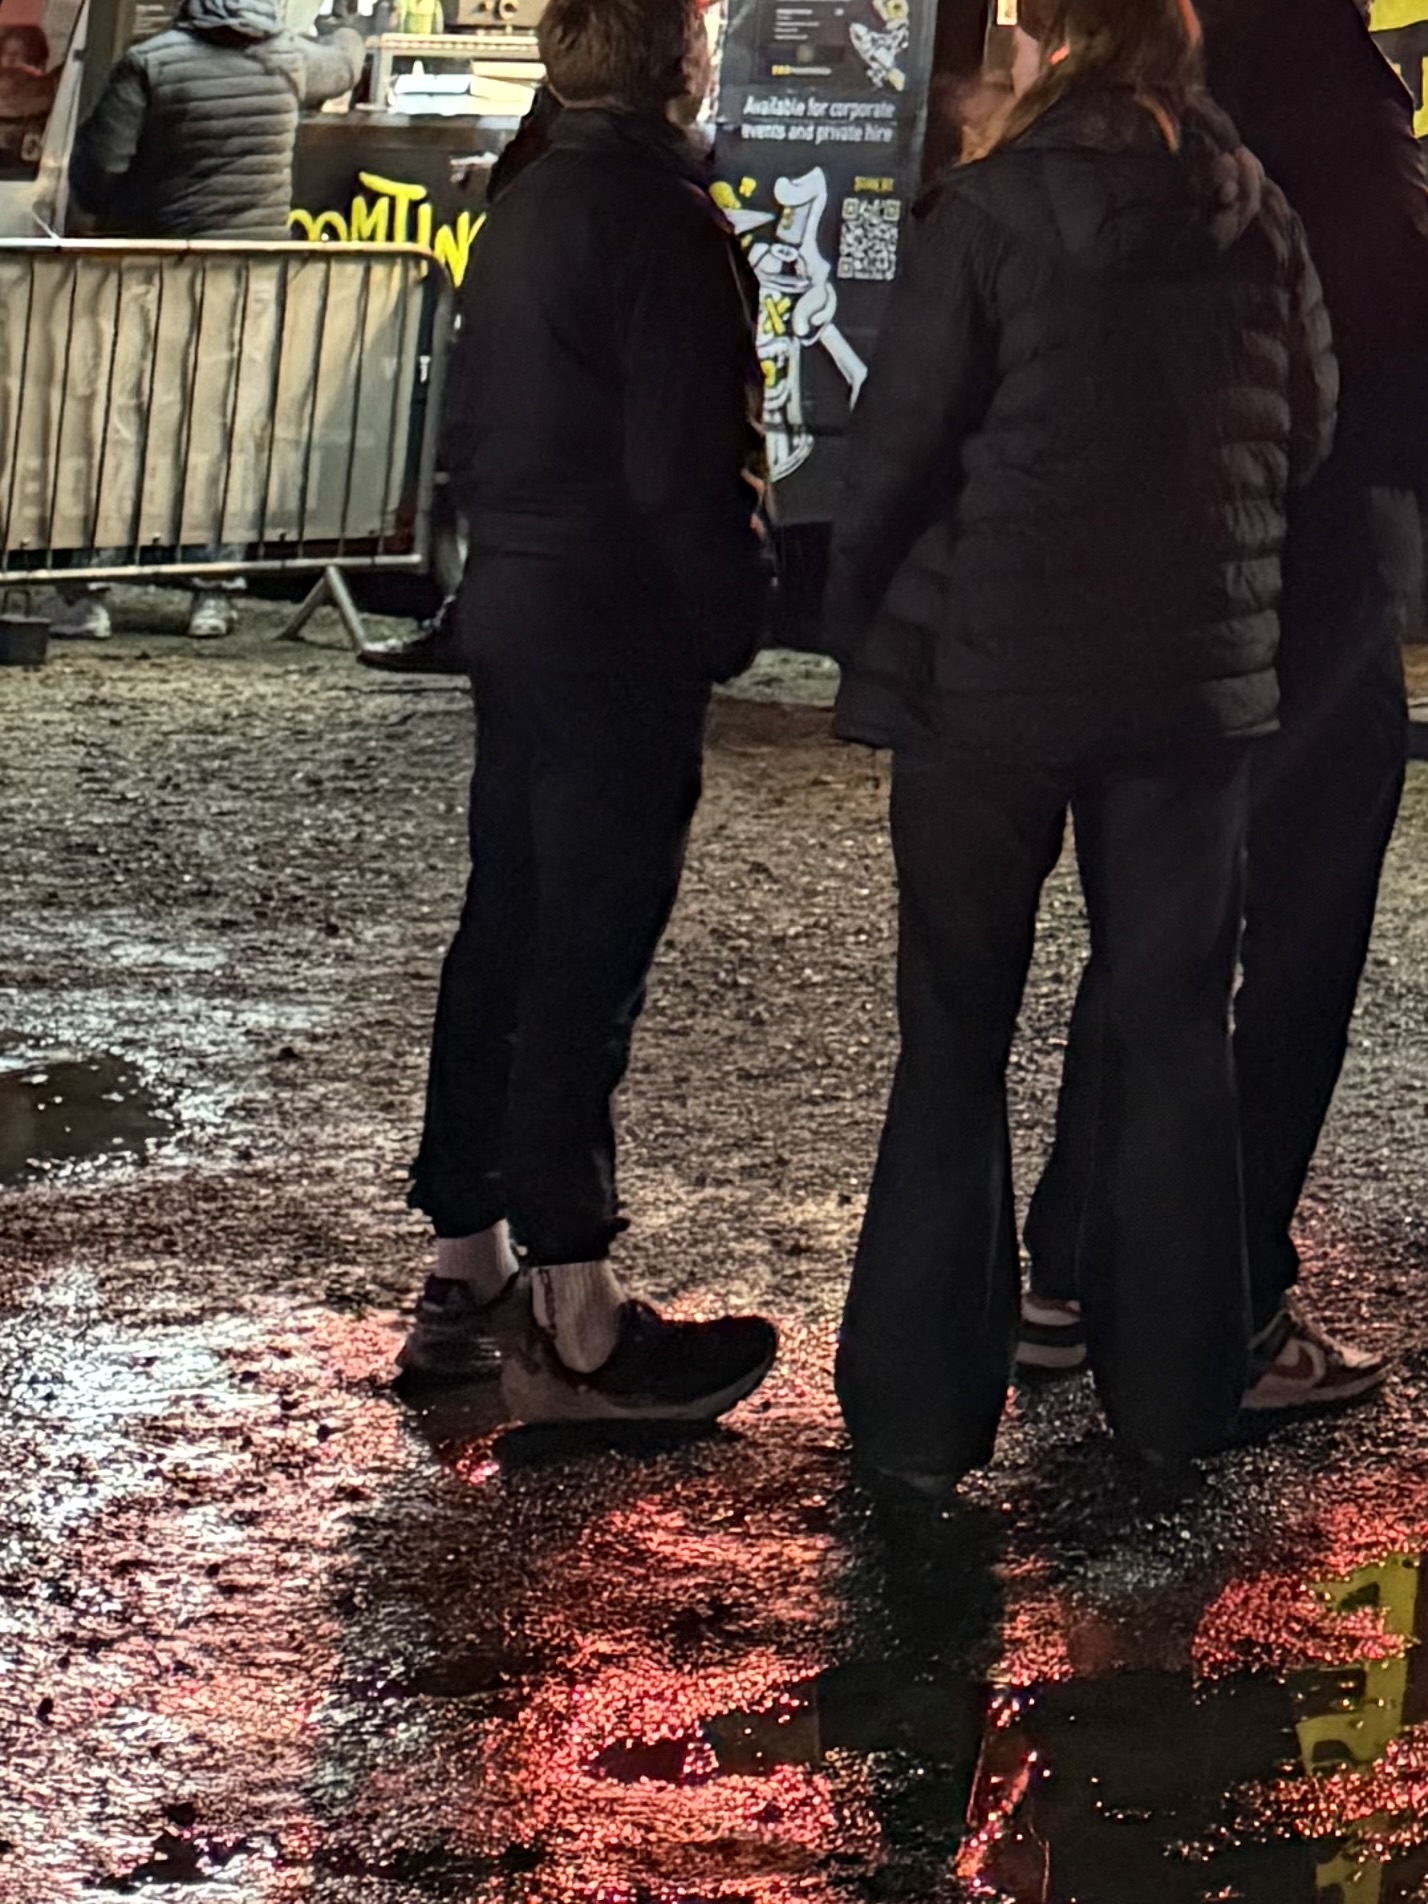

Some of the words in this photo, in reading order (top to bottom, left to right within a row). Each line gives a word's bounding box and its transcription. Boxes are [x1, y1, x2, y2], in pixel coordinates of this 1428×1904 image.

[743, 96, 806, 116] Available
[807, 97, 827, 117] for
[829, 101, 895, 122] corporate
[740, 123, 787, 139] events
[788, 124, 814, 141] and
[814, 124, 864, 146] private
[864, 123, 894, 142] hire
